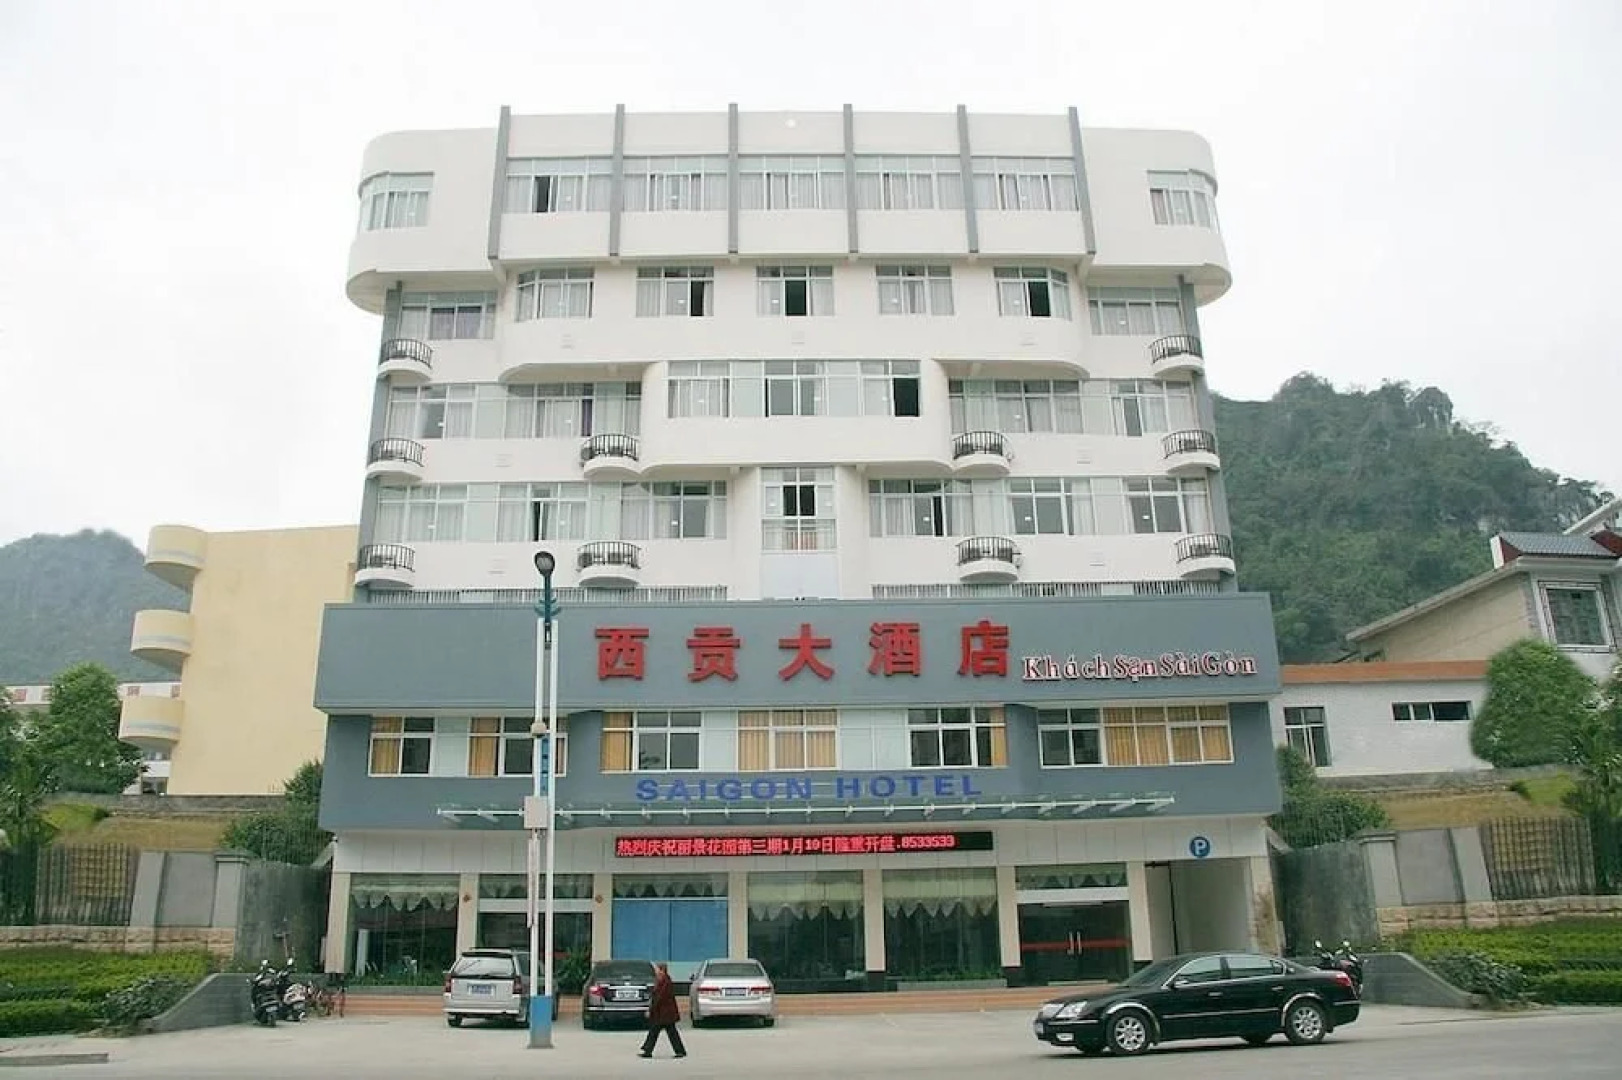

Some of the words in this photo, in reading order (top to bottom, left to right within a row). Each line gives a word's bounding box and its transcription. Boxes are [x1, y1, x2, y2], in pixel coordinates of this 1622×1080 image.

[595, 620, 1010, 682] 西贡大酒店
[636, 777, 813, 802] SAIGON
[836, 774, 982, 799] HOTEL
[1194, 839, 1207, 856] P
